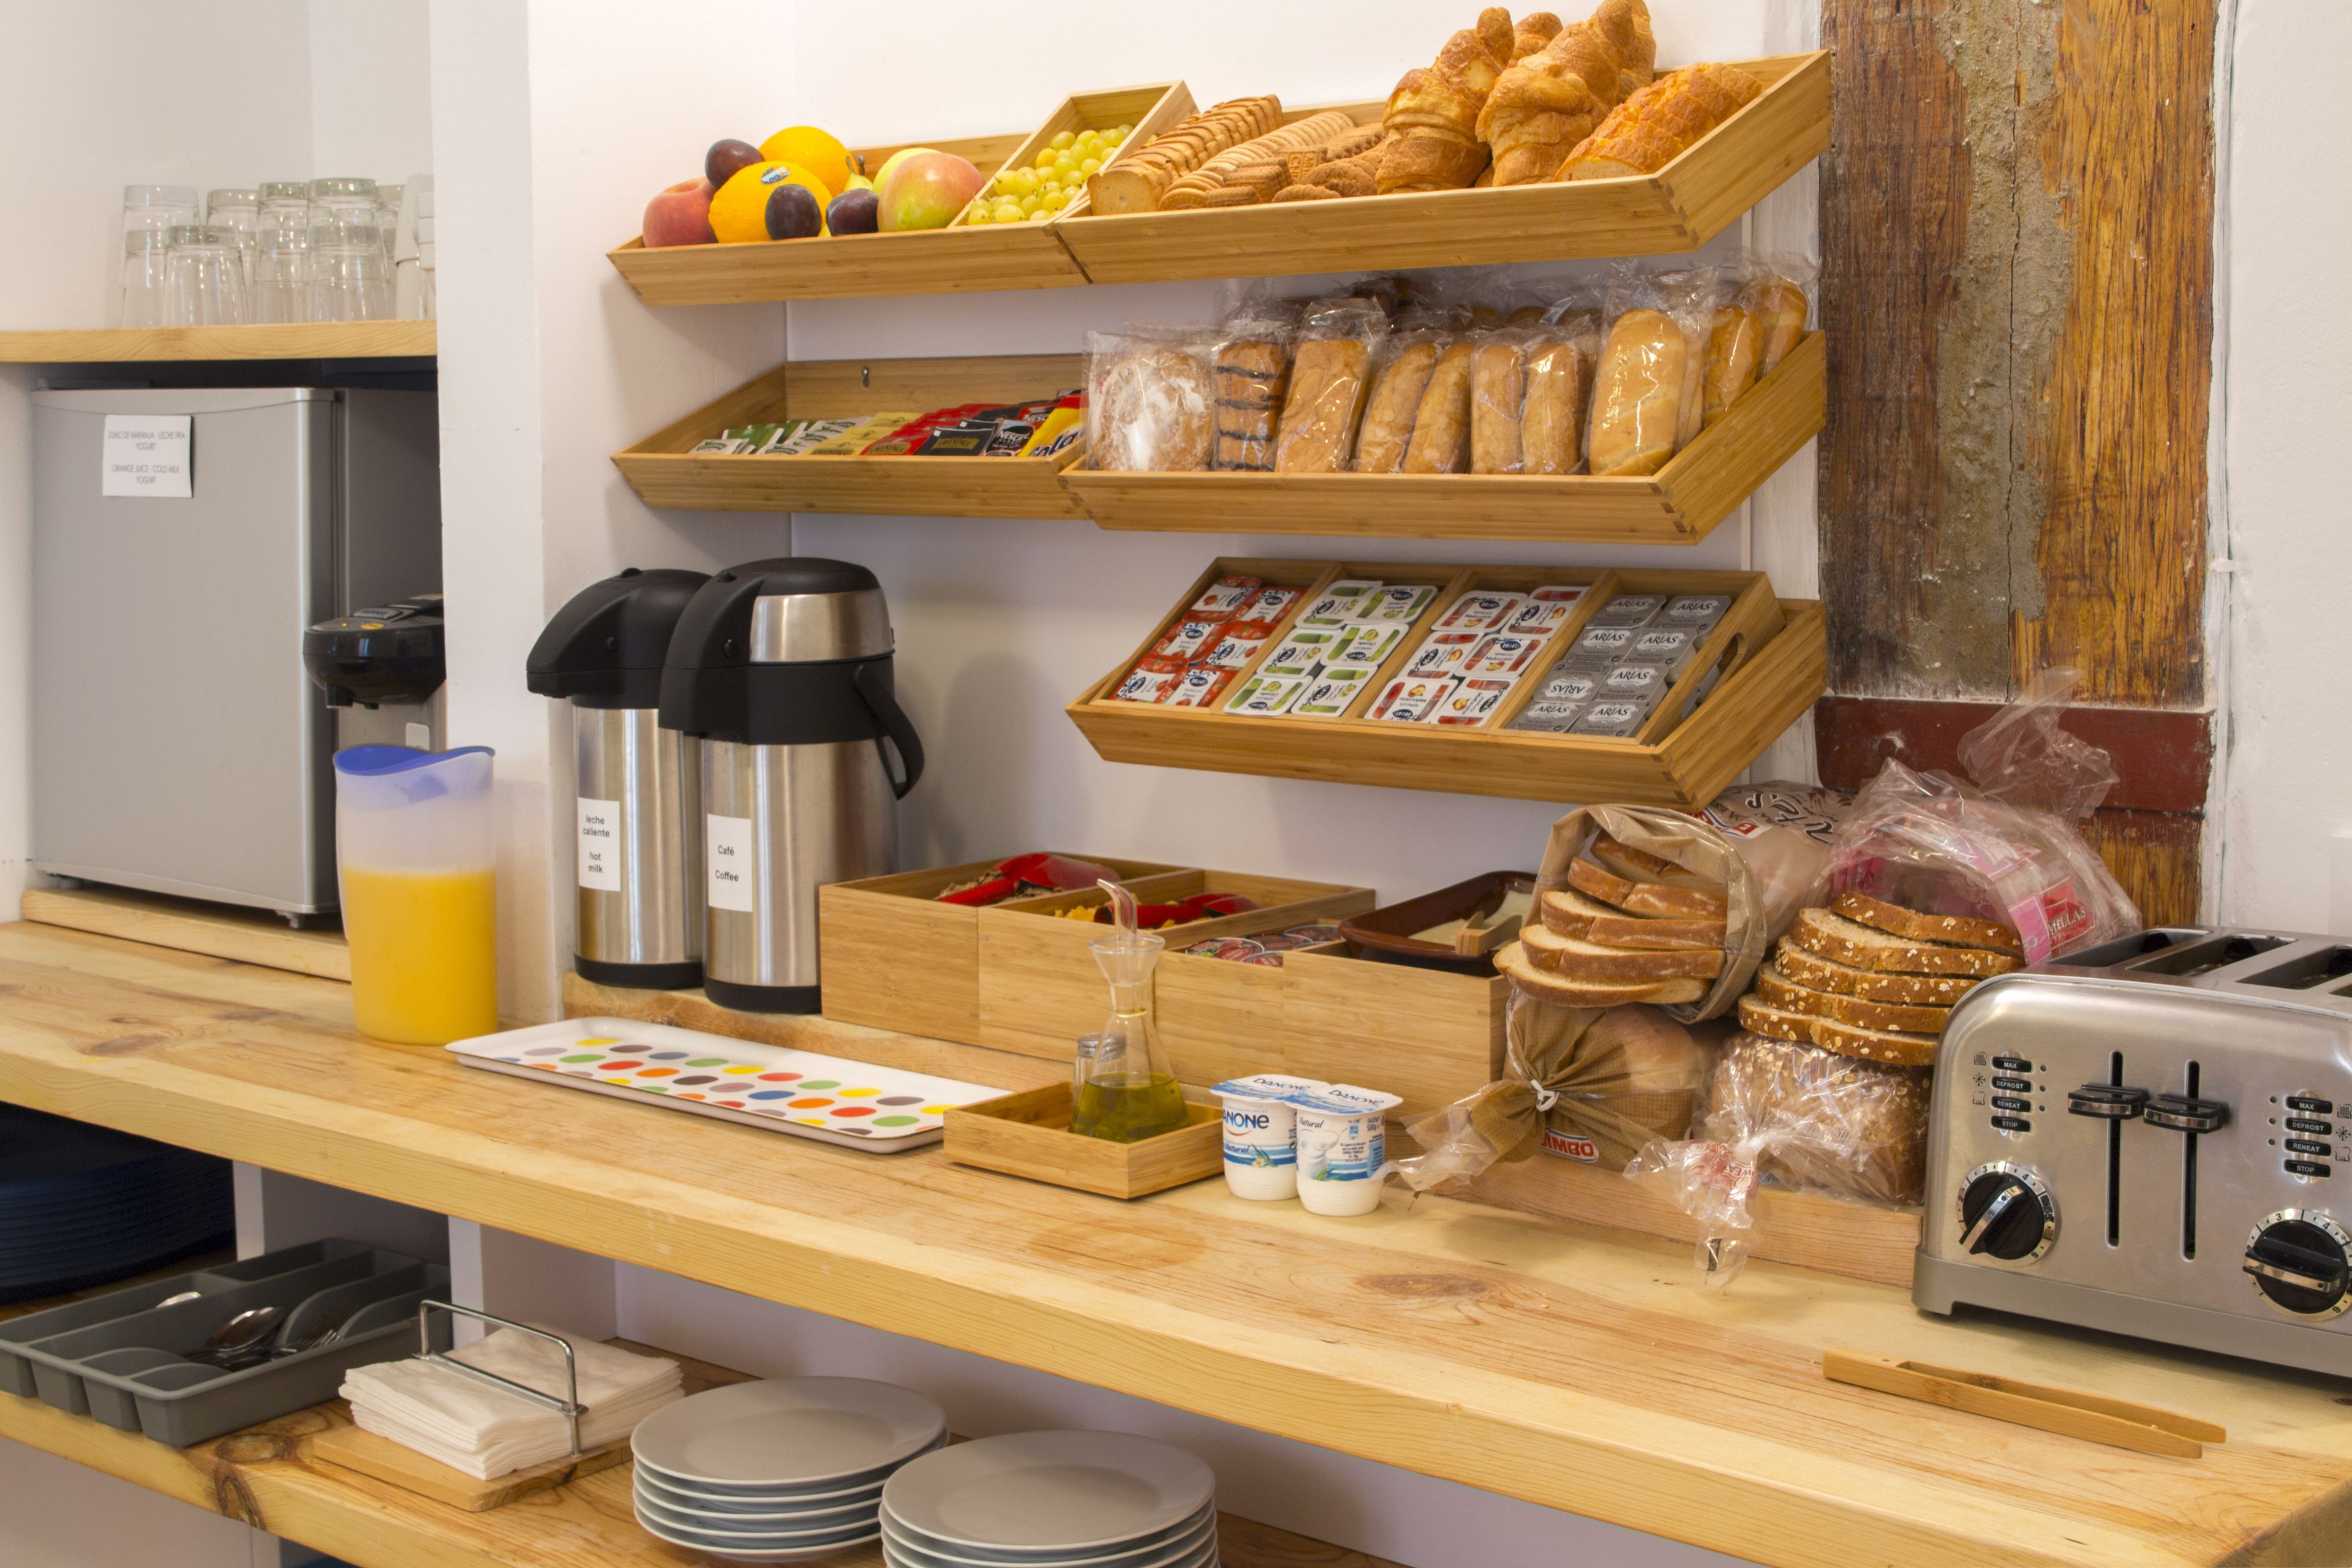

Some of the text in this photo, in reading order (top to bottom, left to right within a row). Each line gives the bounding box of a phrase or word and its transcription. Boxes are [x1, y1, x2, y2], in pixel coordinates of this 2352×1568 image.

[136, 442, 157, 451] YOGURT
[112, 464, 134, 473] ORANGE
[153, 465, 168, 473] COLD
[136, 475, 157, 484] YOGURT
[1677, 602, 1713, 611] ARIAS
[1644, 636, 1679, 644] ARIAS
[1615, 671, 1650, 680] ARIAS
[1550, 684, 1586, 695] ARIAS
[1534, 705, 1570, 714] ARIAS
[1594, 707, 1630, 717] ARIAS
[586, 815, 605, 825] leche
[582, 828, 610, 837] caliente
[718, 845, 734, 856] Café
[589, 851, 601, 861] hot
[588, 864, 603, 873] milk
[715, 870, 739, 882] Coffee
[2047, 905, 2087, 935] MILLAS
[1253, 1077, 1311, 1090] DANONE
[1996, 1080, 2024, 1089] DEFROST
[1328, 1090, 1385, 1105] DANONE
[1997, 1100, 2021, 1109] REHEAT
[1223, 1108, 1270, 1129] ANONE
[1299, 1116, 1325, 1129] Natural
[2293, 1121, 2324, 1131] DEFROST
[1225, 1142, 1251, 1154] Natural
[2293, 1142, 2321, 1152] REHEAT
[2275, 1213, 2282, 1221] 3
